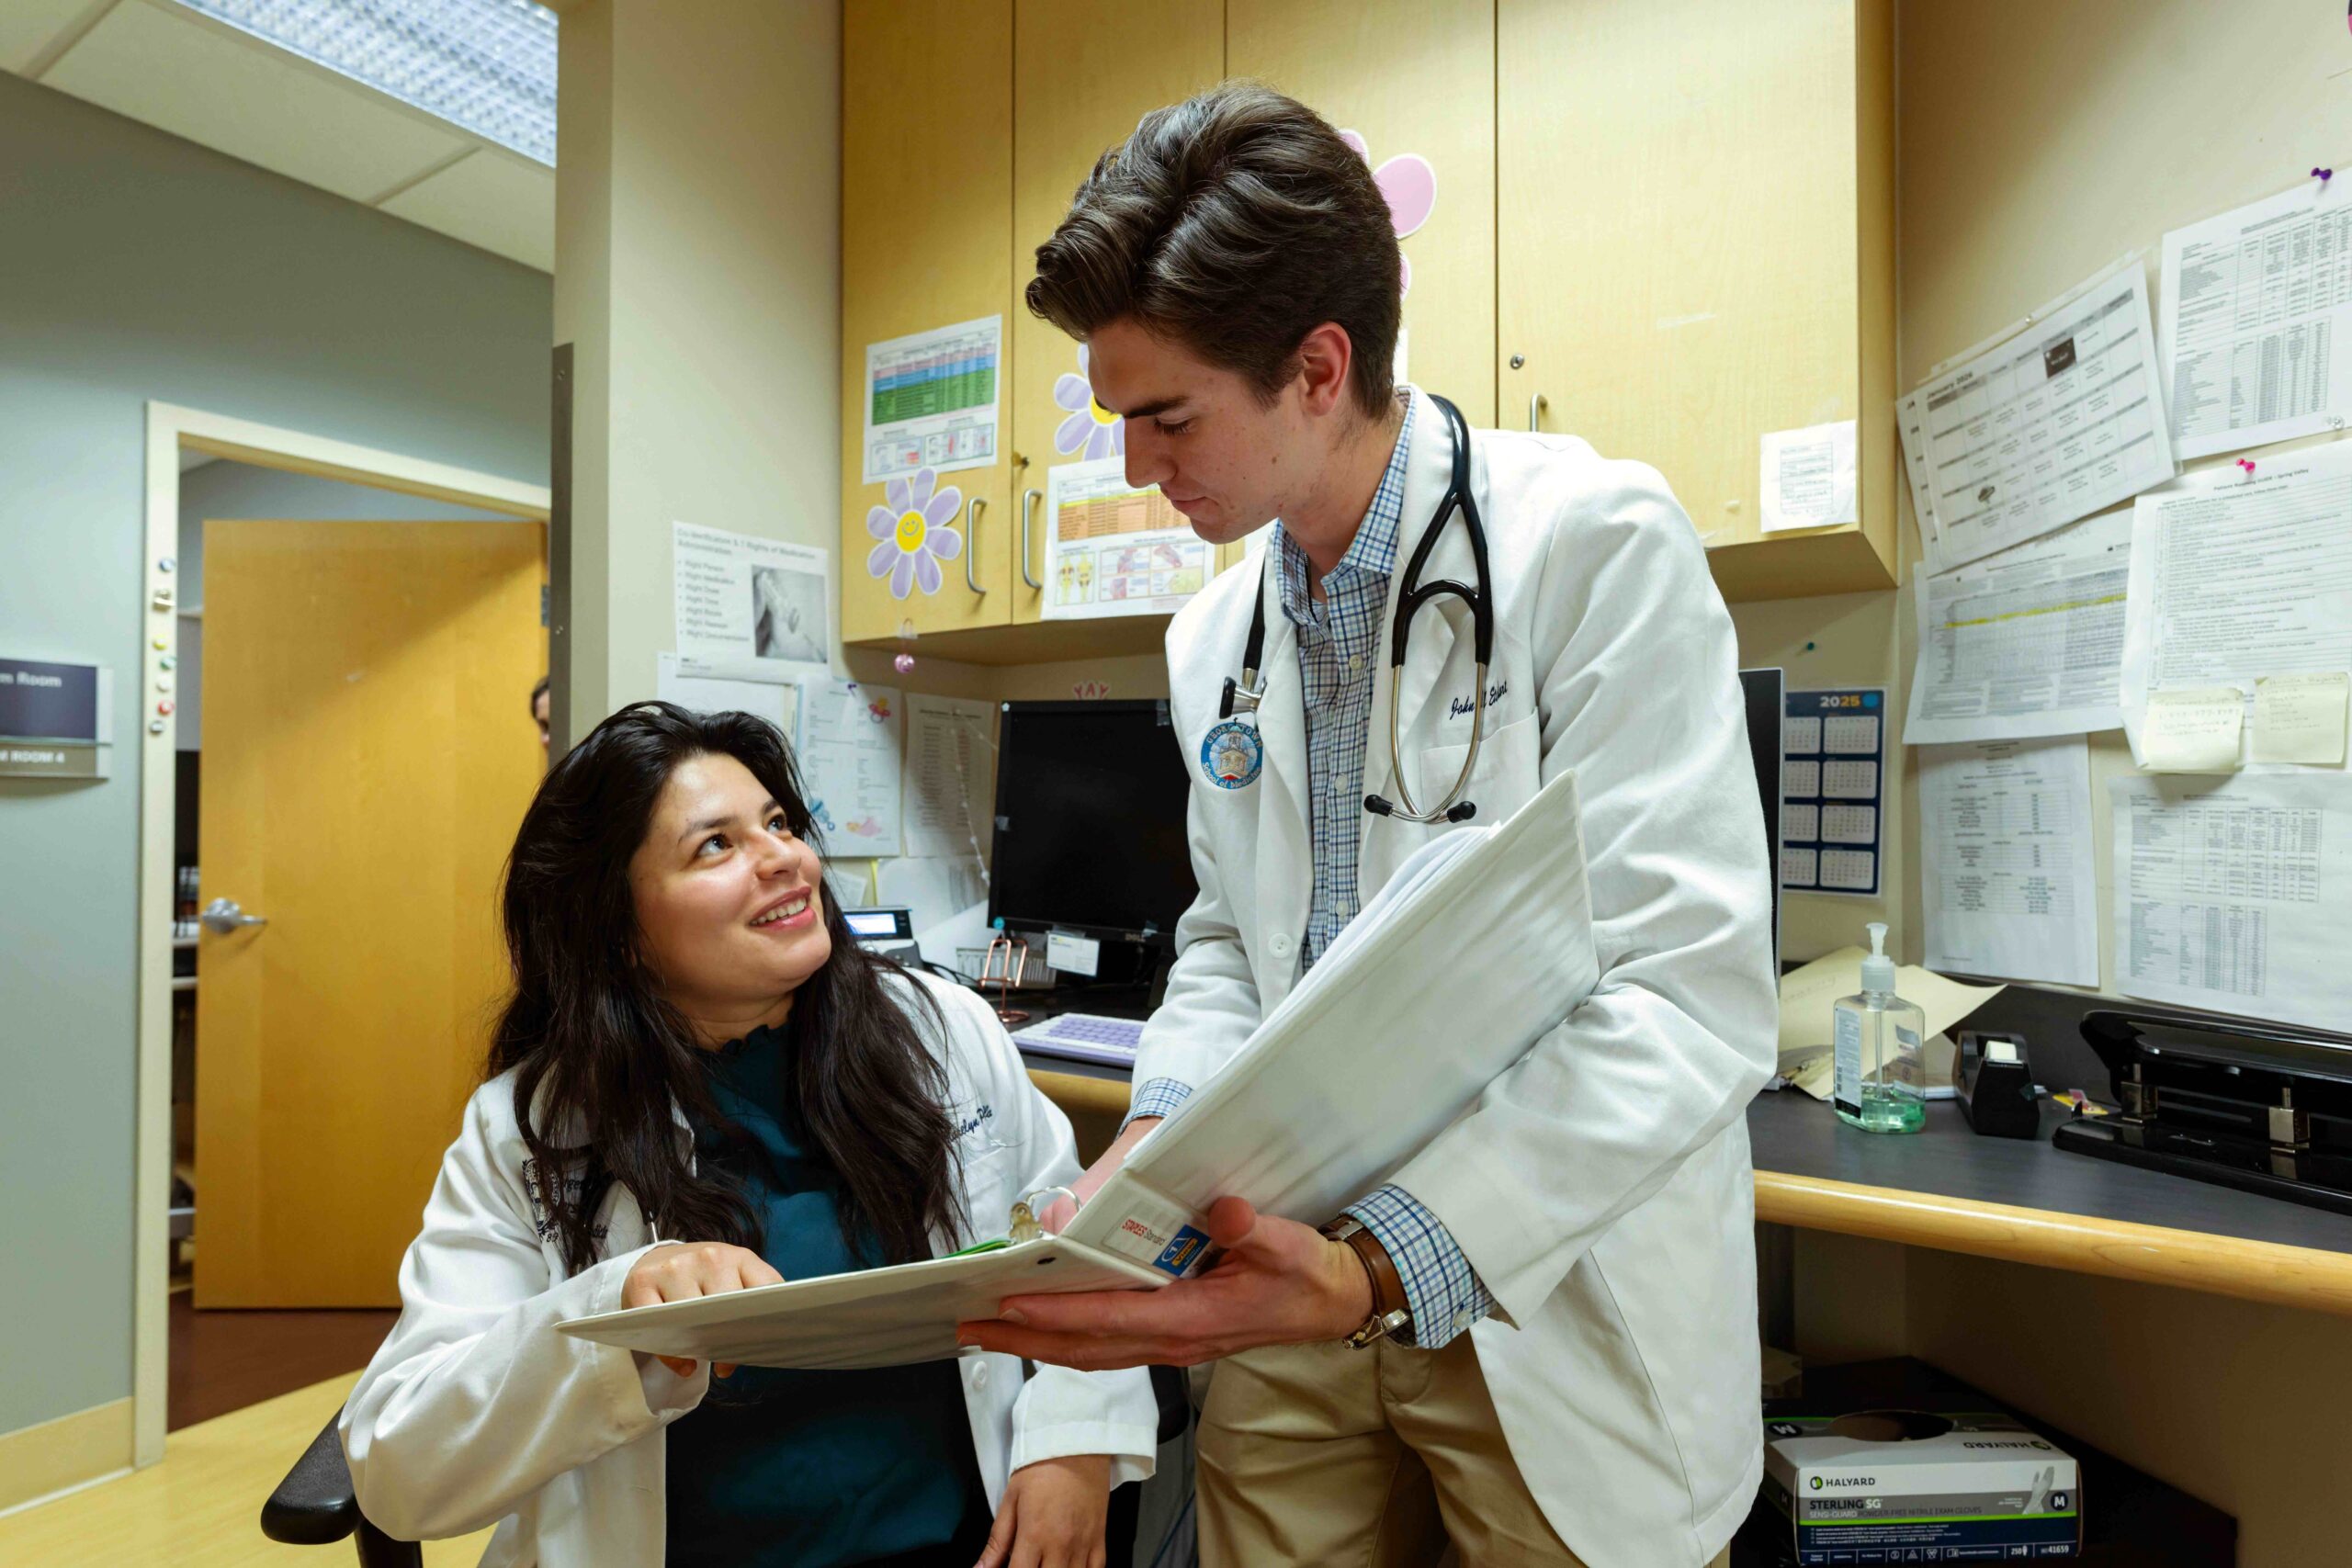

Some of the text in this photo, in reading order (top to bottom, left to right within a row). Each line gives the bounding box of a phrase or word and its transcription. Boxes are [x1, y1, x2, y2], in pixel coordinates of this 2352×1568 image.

[17, 671, 62, 688] Room
[1073, 682, 1109, 699] YAY
[1819, 694, 1861, 708] 2025
[1826, 1477, 1876, 1487] HALYARD
[1809, 1499, 1864, 1510] STERLING
[2053, 1495, 2065, 1506] M
[1809, 1510, 1858, 1519] SENSI-GUARD
[2048, 1544, 2070, 1554] 41659
